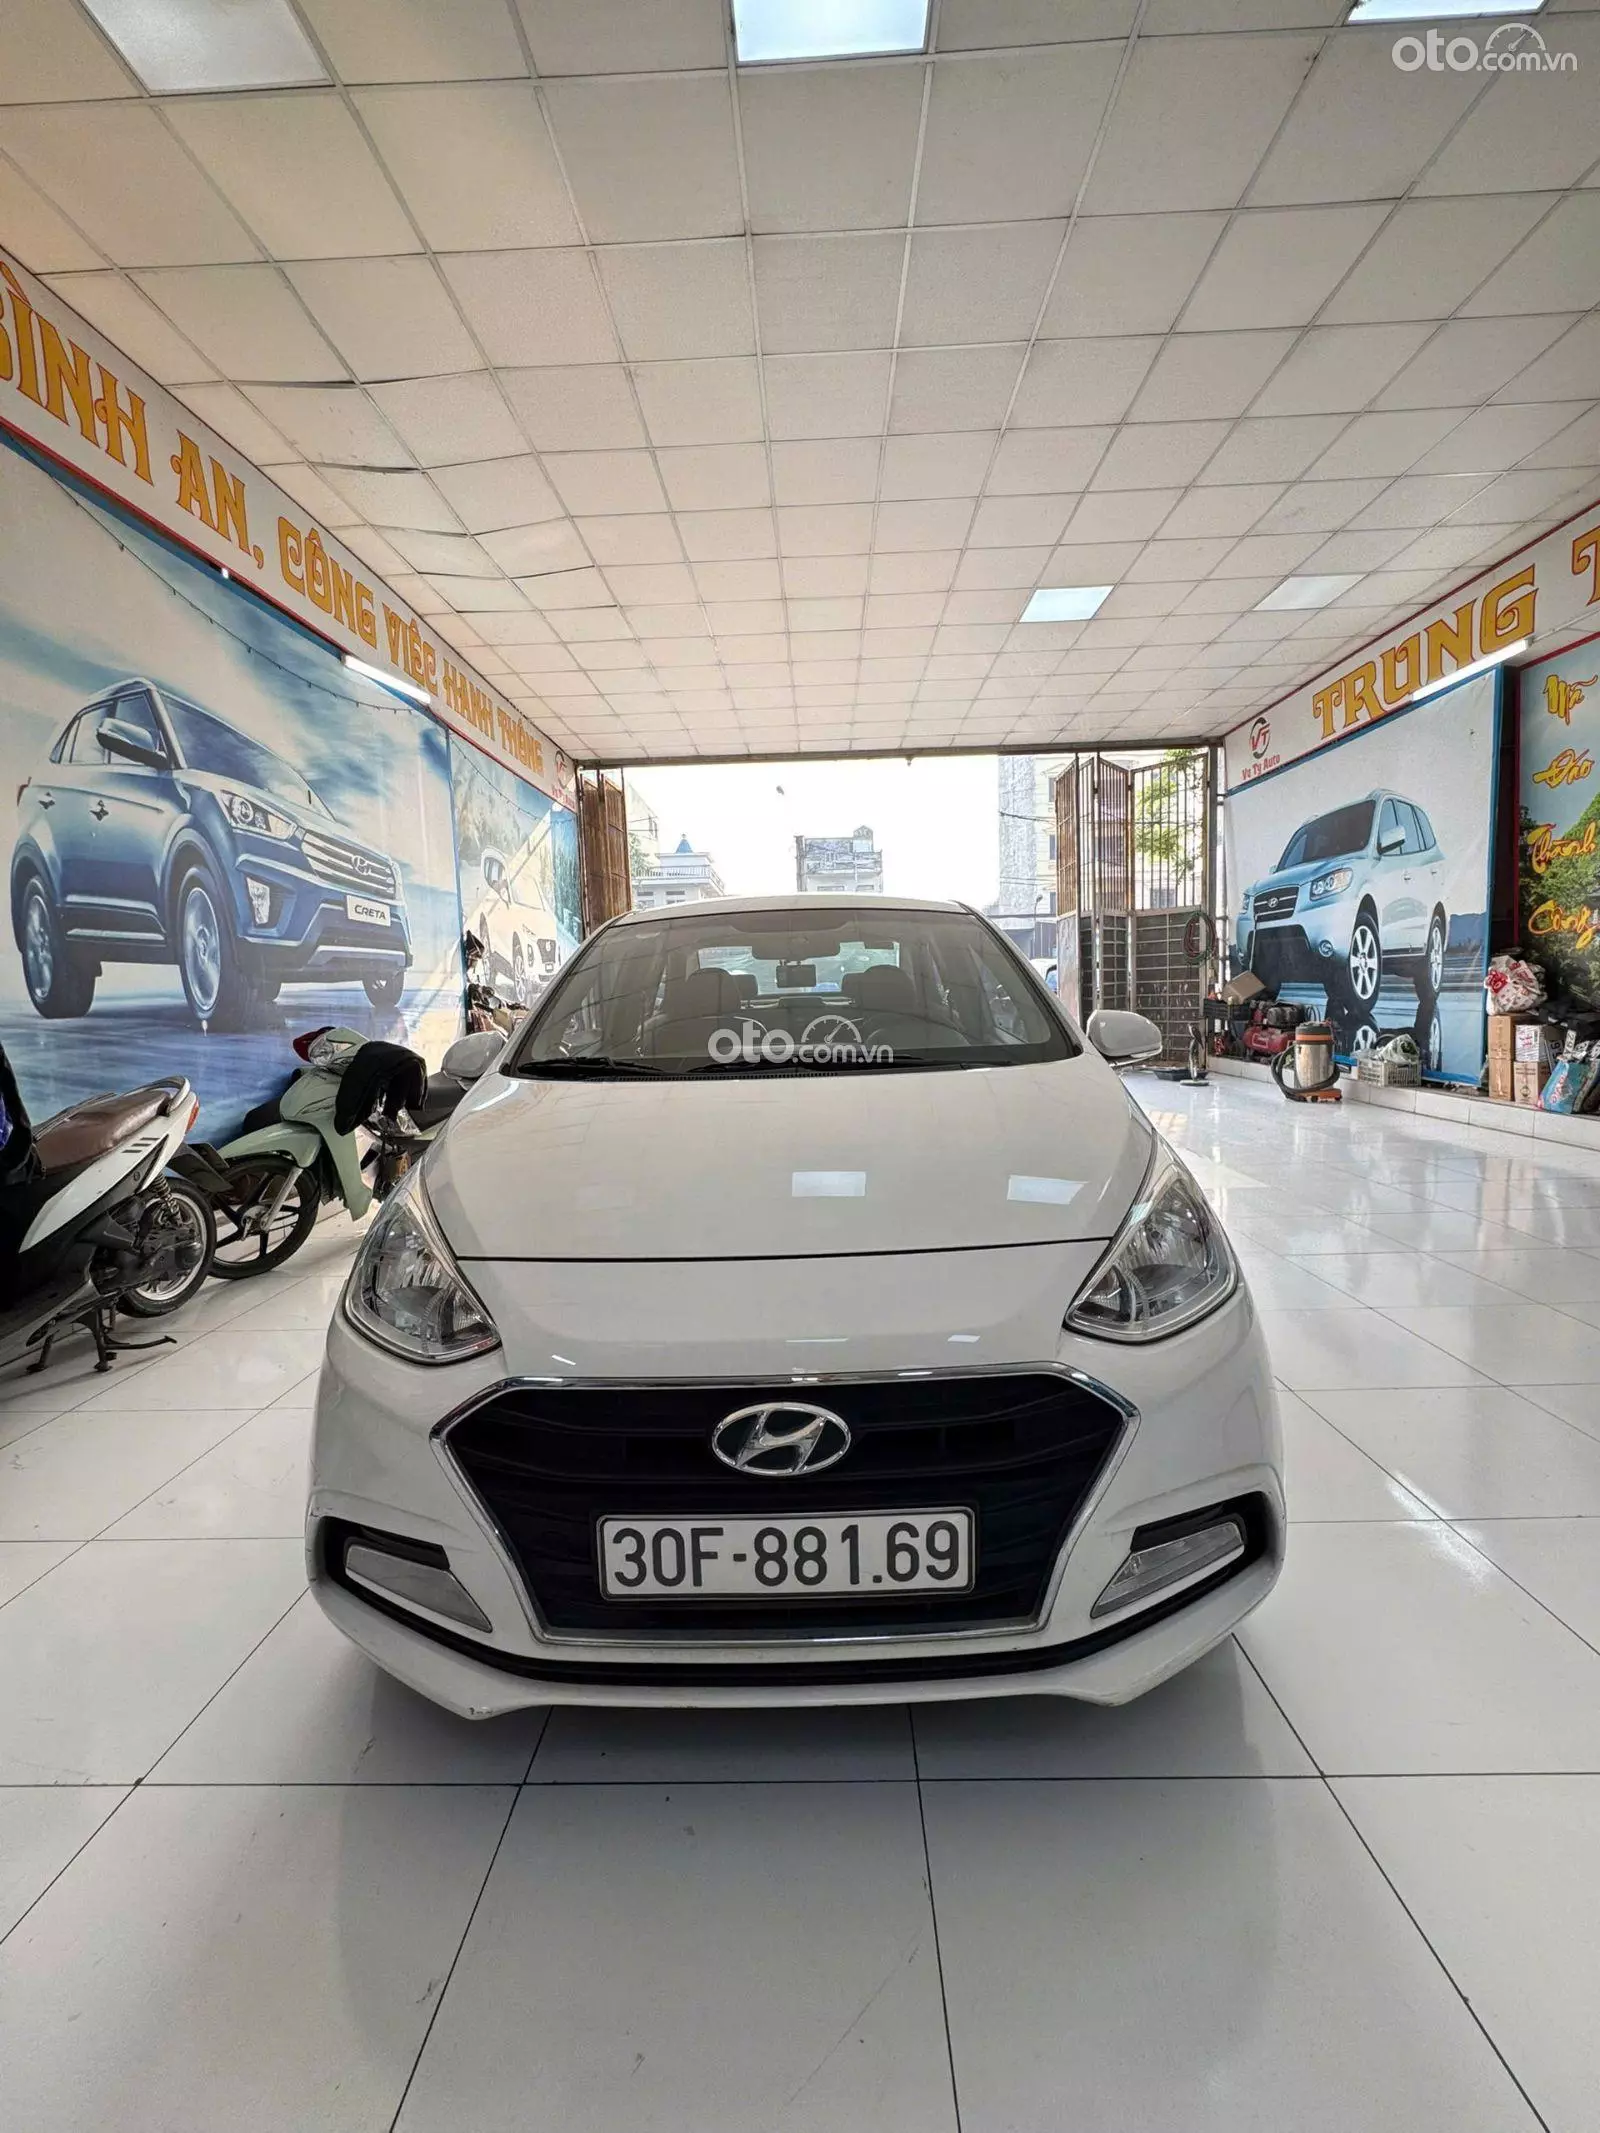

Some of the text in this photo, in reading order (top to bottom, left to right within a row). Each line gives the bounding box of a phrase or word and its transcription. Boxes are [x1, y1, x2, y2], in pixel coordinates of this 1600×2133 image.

[170, 428, 264, 570] AN,
[277, 516, 377, 650] CÔNG
[1312, 562, 1539, 740] TRUNG
[354, 904, 386, 920] CRETA
[612, 1519, 960, 1588] 30F-881.69
